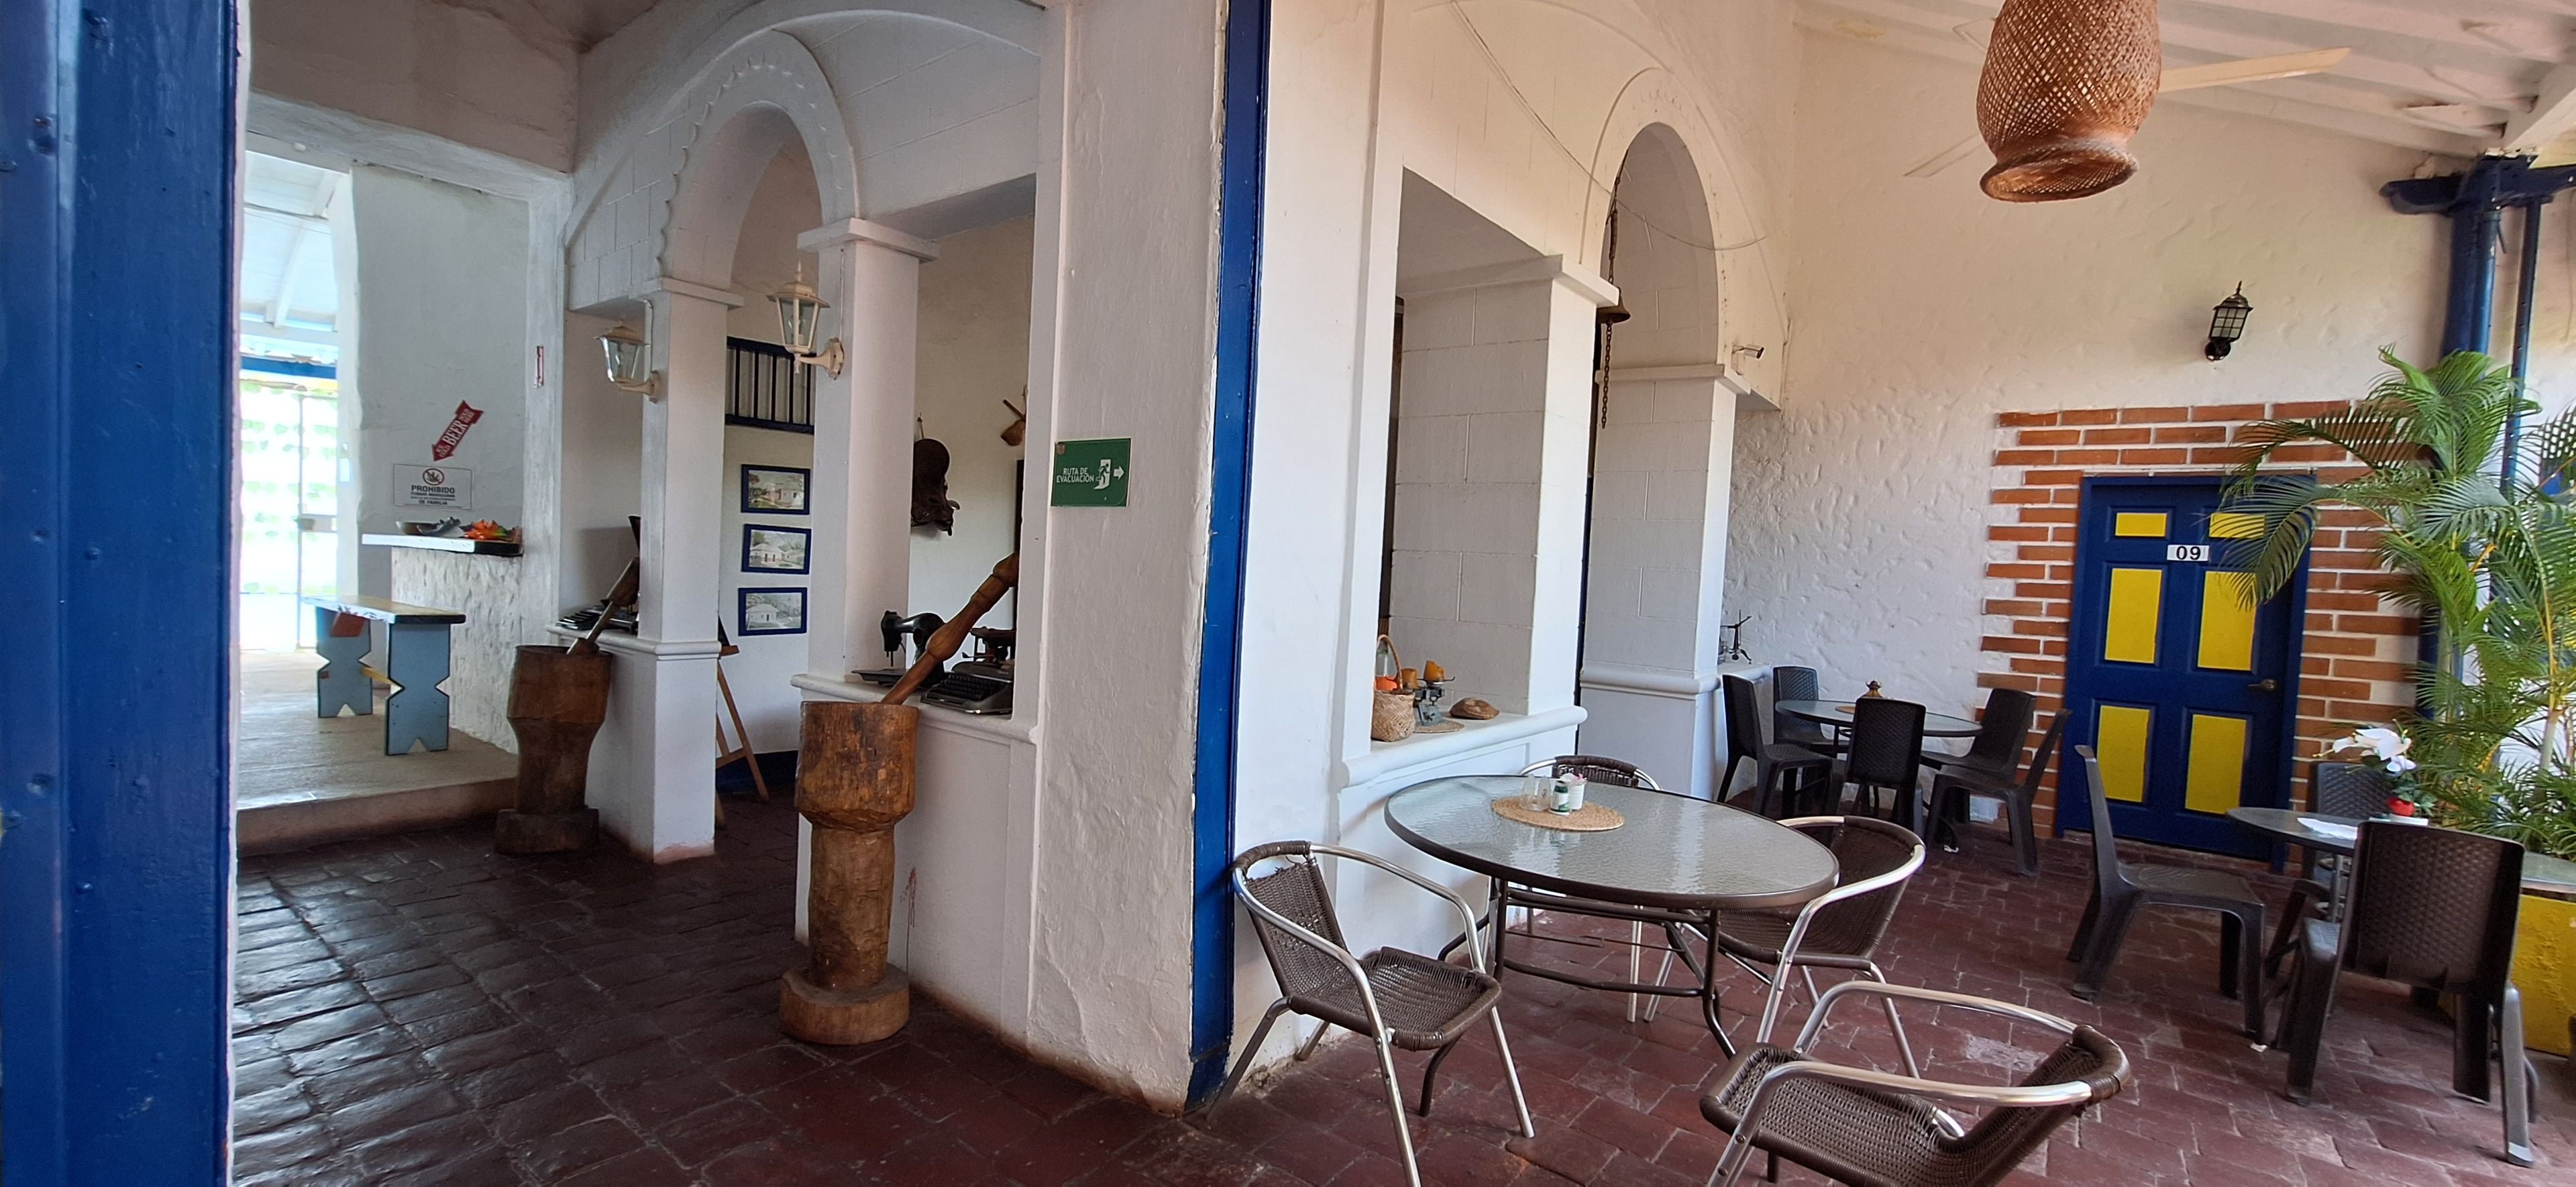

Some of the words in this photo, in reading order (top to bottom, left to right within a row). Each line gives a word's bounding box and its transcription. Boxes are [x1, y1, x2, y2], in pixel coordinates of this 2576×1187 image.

[442, 420, 468, 446] BEER
[411, 485, 455, 494] PROHIBIDO
[2176, 546, 2201, 560] 09
